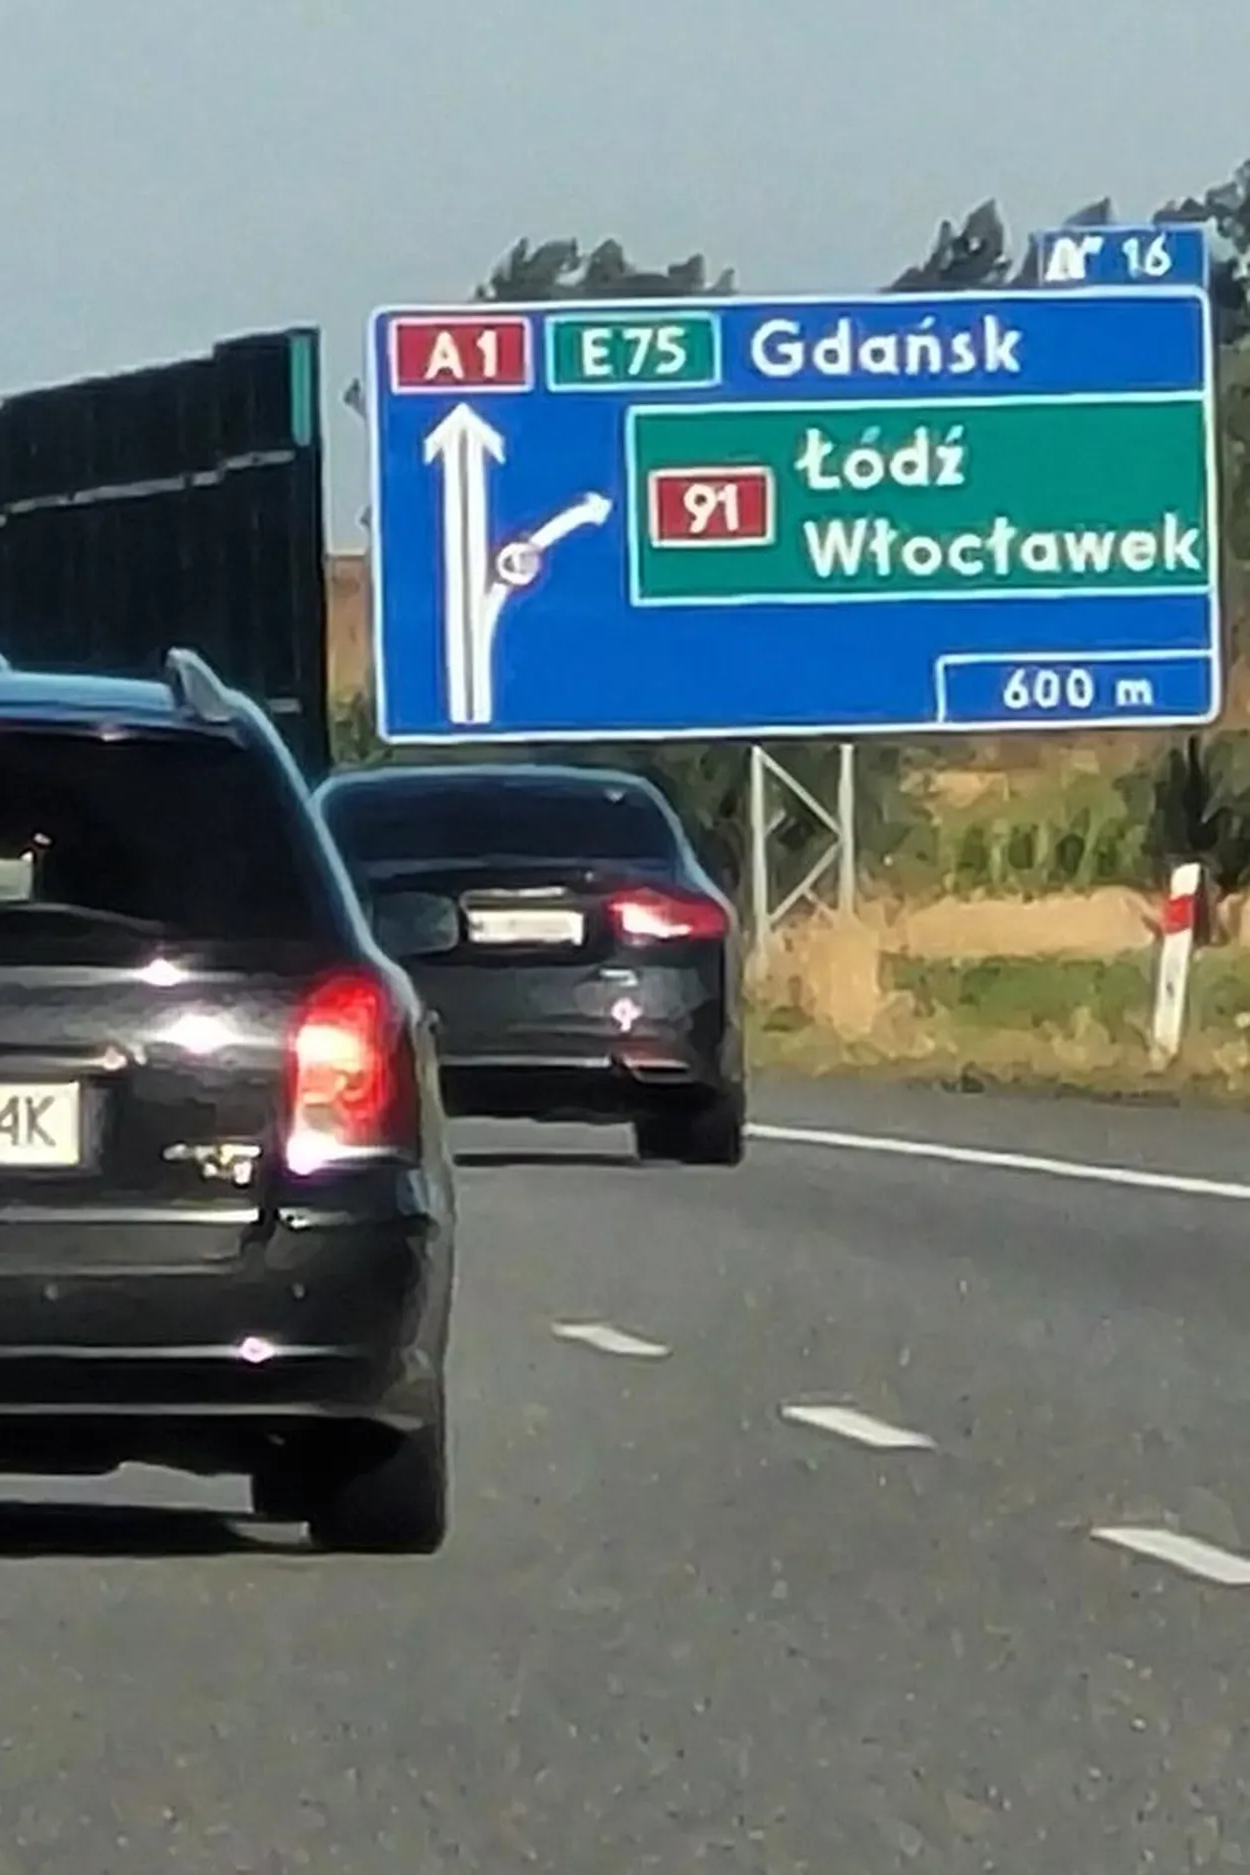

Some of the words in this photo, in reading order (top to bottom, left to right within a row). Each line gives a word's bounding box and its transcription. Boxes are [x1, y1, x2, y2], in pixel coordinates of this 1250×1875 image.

[1122, 231, 1172, 278] 16
[424, 329, 497, 380] A1
[582, 327, 687, 376] E75
[752, 315, 1022, 377] Gdańsk
[795, 425, 965, 490] Łódź
[683, 484, 739, 533] 91
[803, 512, 1203, 578] Włocławek
[1004, 668, 1093, 709] 600
[1116, 679, 1153, 706] m
